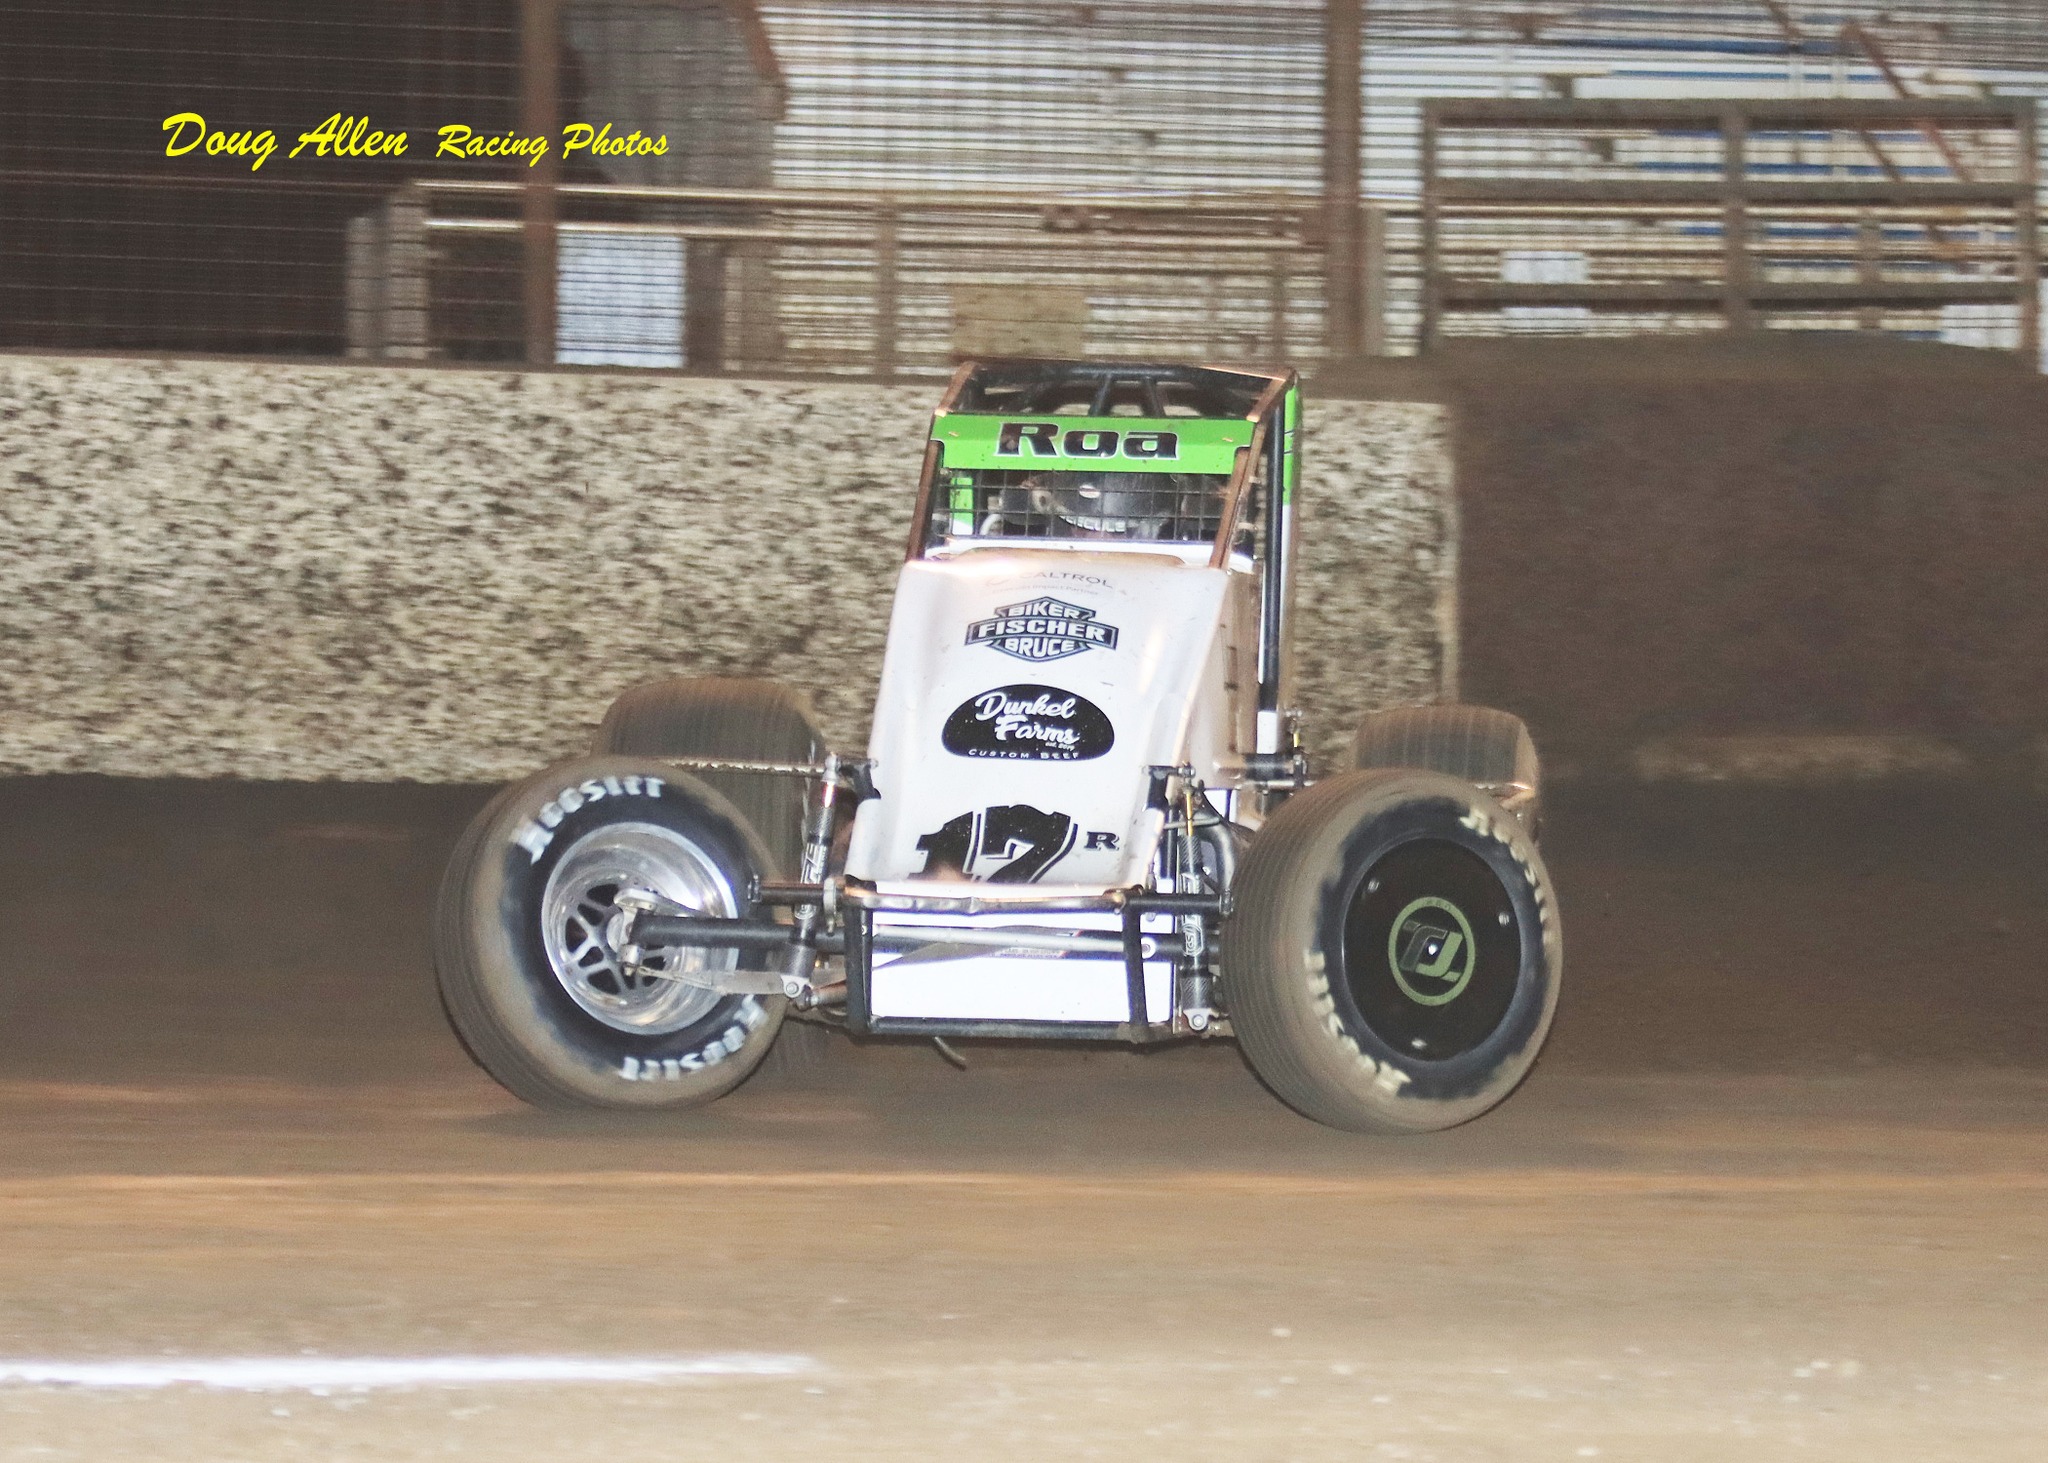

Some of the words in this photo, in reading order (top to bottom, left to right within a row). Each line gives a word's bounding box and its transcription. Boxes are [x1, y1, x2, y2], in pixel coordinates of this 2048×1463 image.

[994, 422, 1180, 460] Roa
[1008, 601, 1081, 618] BIKER
[977, 619, 1106, 642] FISCHER
[1004, 638, 1075, 657] BRUCE
[975, 692, 1076, 721] Dunkel
[994, 715, 1080, 744] Farms
[968, 748, 1029, 759] CUSTOM
[1040, 752, 1079, 760] BEEF
[907, 804, 1078, 883] 17
[1084, 831, 1120, 851] R
